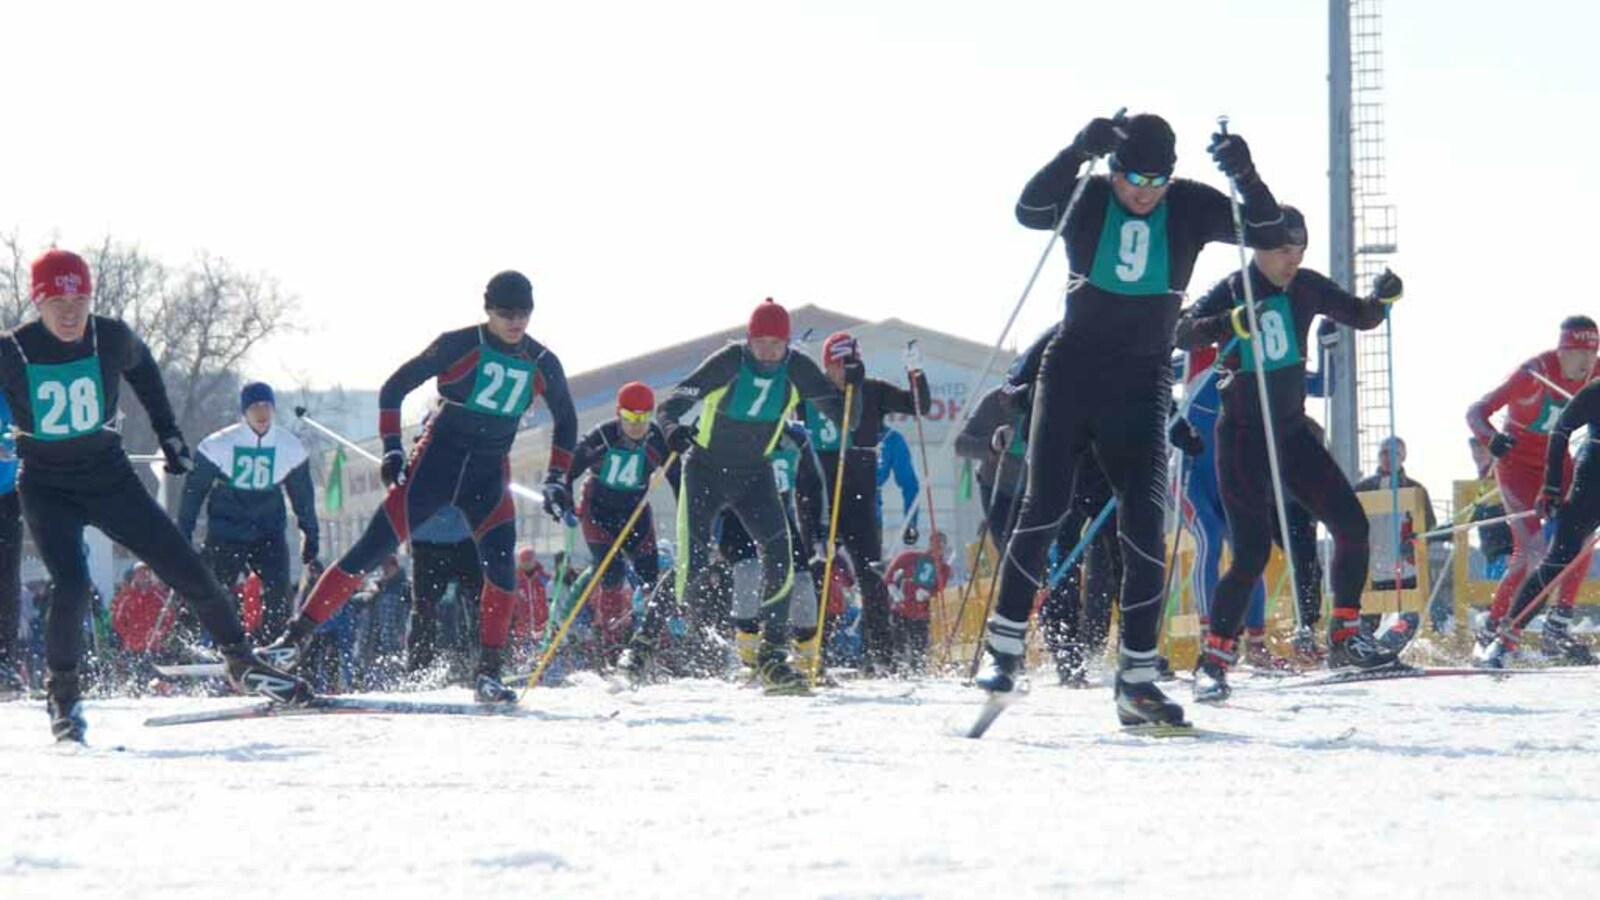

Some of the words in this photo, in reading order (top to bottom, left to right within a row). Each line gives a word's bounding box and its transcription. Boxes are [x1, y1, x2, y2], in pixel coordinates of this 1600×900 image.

[1115, 220, 1151, 282] 9
[37, 376, 100, 434] 28
[475, 361, 529, 413] 27
[746, 376, 773, 417] 7
[234, 455, 271, 490] 26
[606, 453, 640, 486] 14
